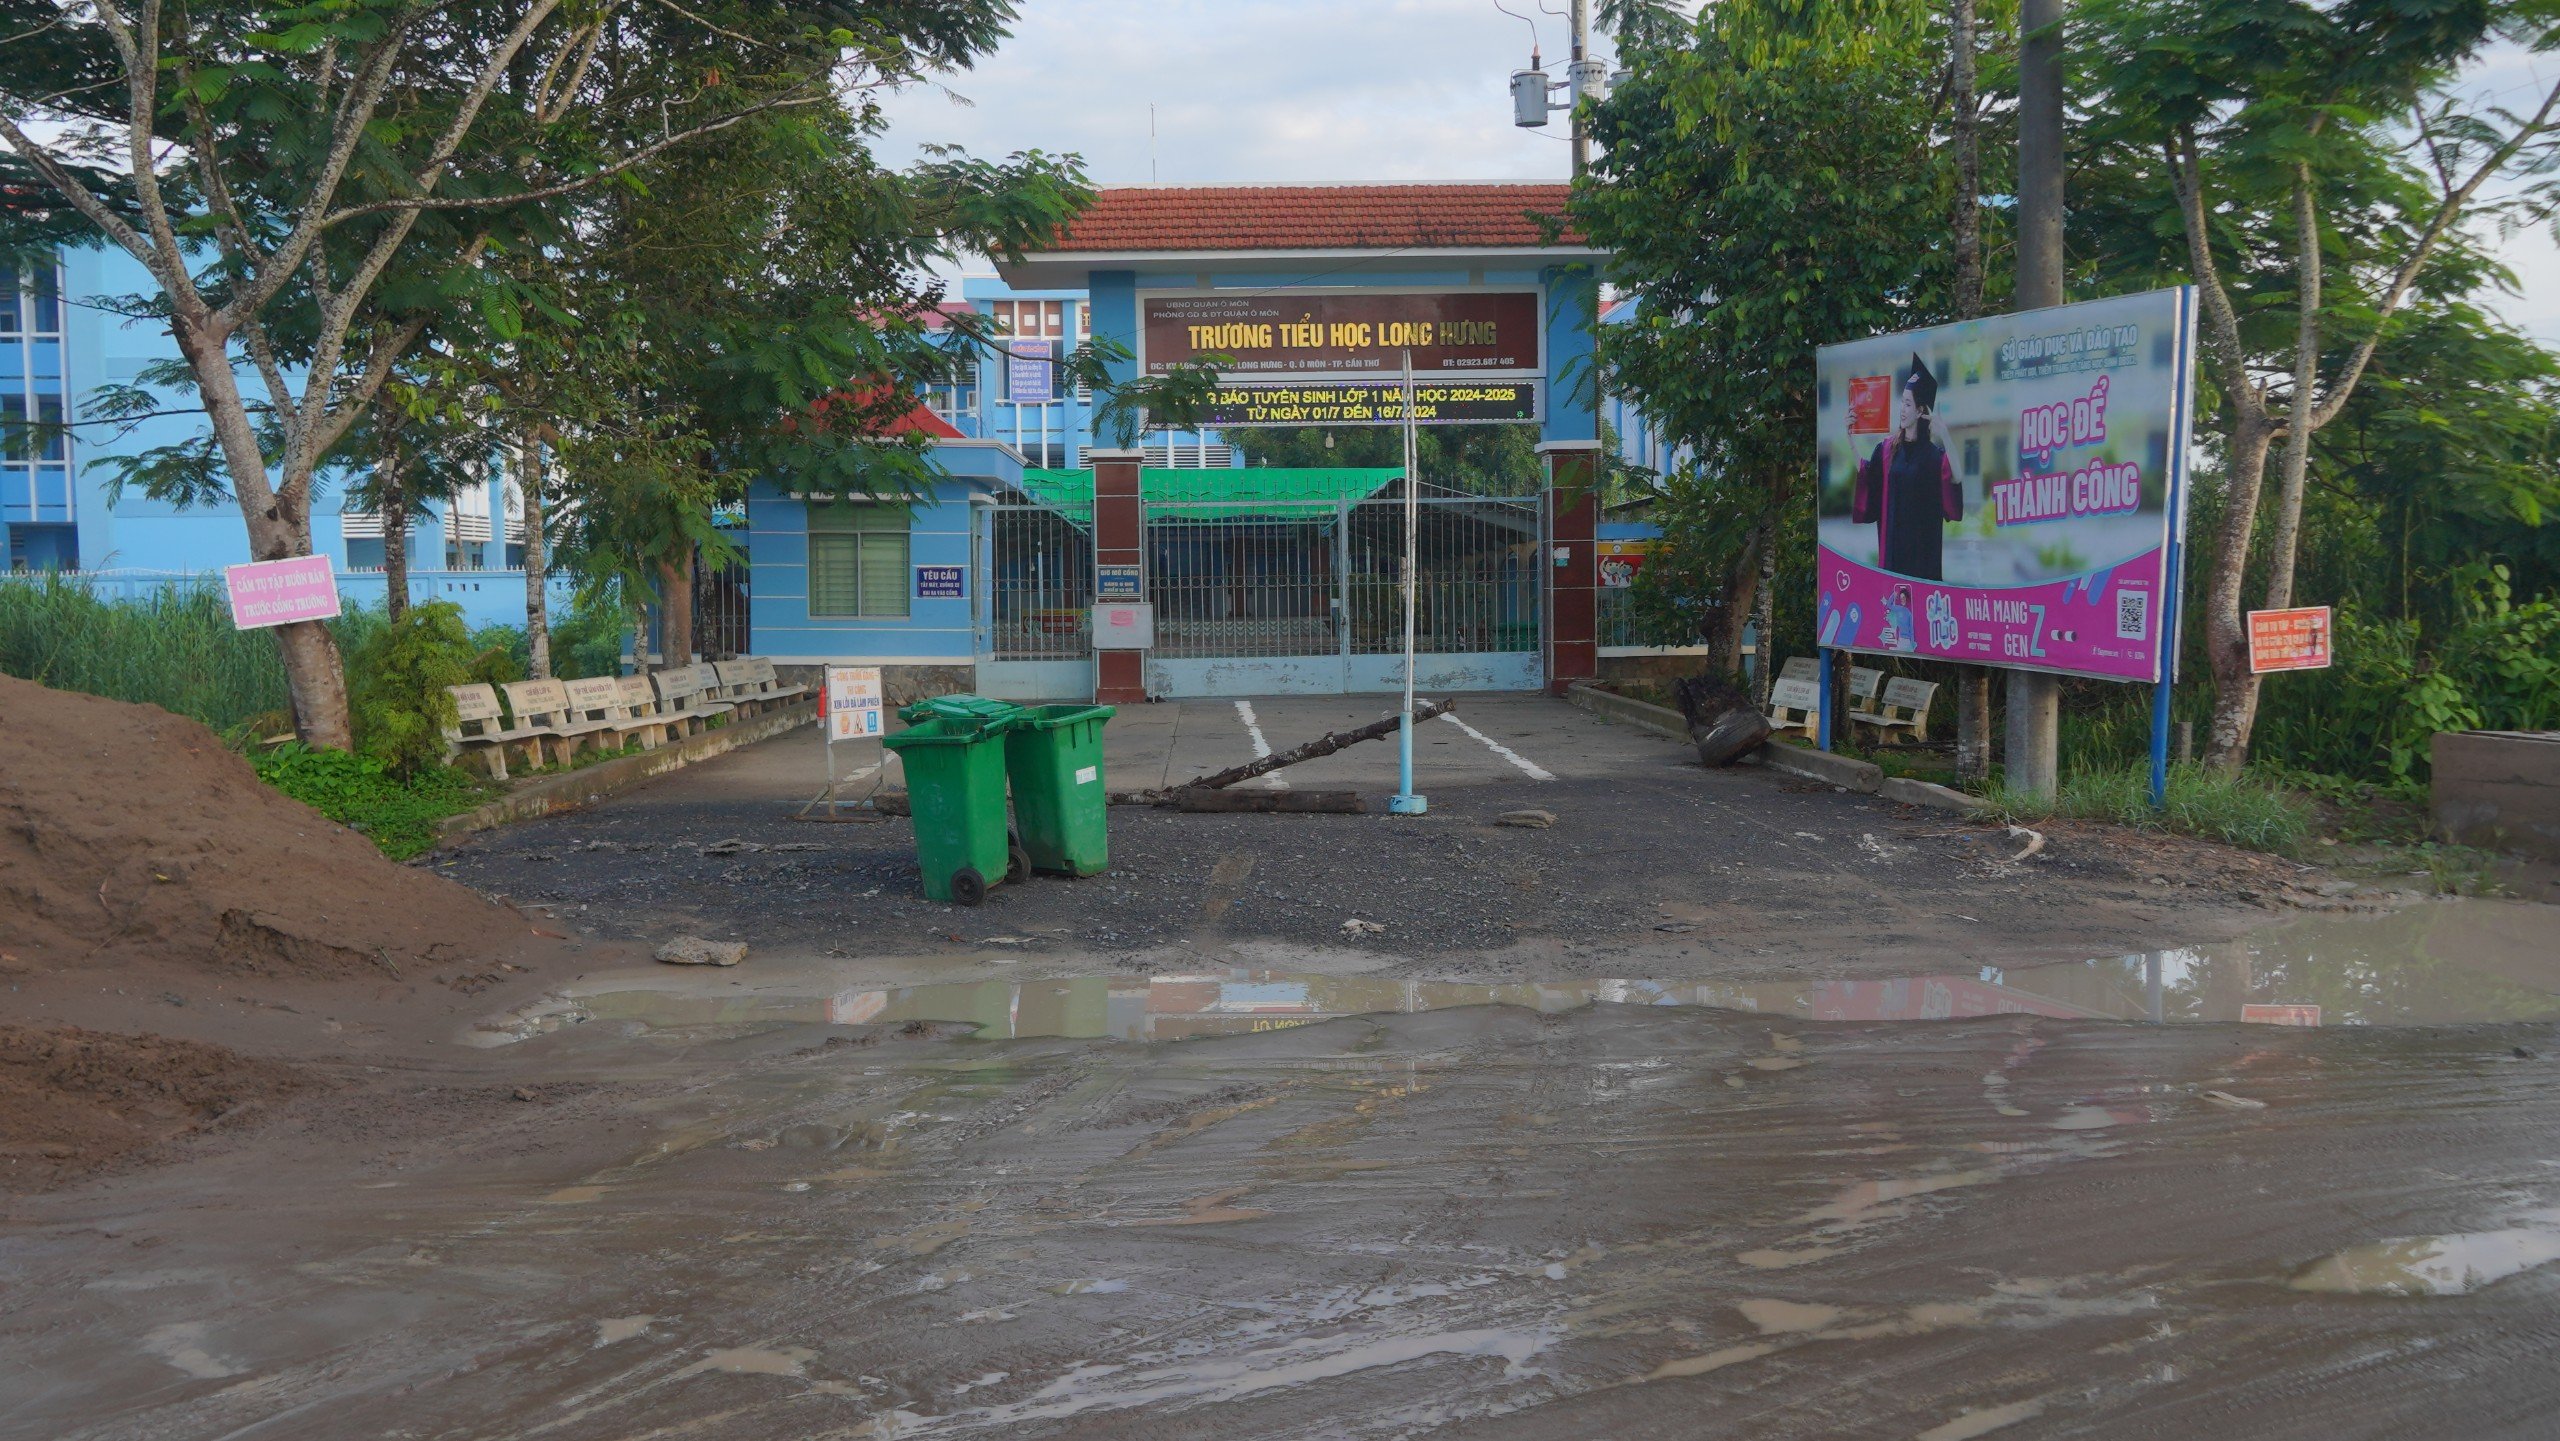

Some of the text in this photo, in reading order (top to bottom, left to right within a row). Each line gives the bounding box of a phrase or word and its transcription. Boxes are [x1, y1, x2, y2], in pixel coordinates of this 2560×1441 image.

[1153, 310, 1184, 318] PHÒNG
[1260, 309, 1280, 317] MÔN
[1279, 313, 1324, 348] TIỂU
[1331, 322, 1371, 352] HỌC
[1378, 322, 1433, 347] LONG
[1439, 319, 1497, 346] HƯNG
[2017, 335, 2043, 360] GIÁO
[2045, 335, 2067, 361] DỤC
[2112, 324, 2138, 353] TẠO
[1237, 362, 1259, 370] LONG
[1260, 361, 1283, 369] HƯNG
[1307, 359, 1326, 368] MÔN
[1364, 359, 1380, 367] THƠ
[1456, 358, 1497, 366] 02923.687
[1499, 357, 1515, 365] 405
[1220, 388, 1249, 405] BÁO
[1302, 391, 1336, 404] SINH
[1339, 387, 1368, 403] LỚP
[1372, 390, 1378, 402] 1
[1382, 387, 1411, 402] NĂ
[1416, 389, 1448, 403] HỌC
[1450, 388, 1516, 402] 2024-2025
[1270, 404, 1310, 419] NGÀY
[1312, 405, 1341, 419] 01/7
[2022, 376, 2109, 461] HỌC ĐỂ
[1992, 458, 2139, 523] THÀNH CÔNG
[923, 570, 939, 580] YÊU
[1965, 593, 2028, 629] NHÀ MẠNG
[2004, 604, 2046, 658] GEN Z
